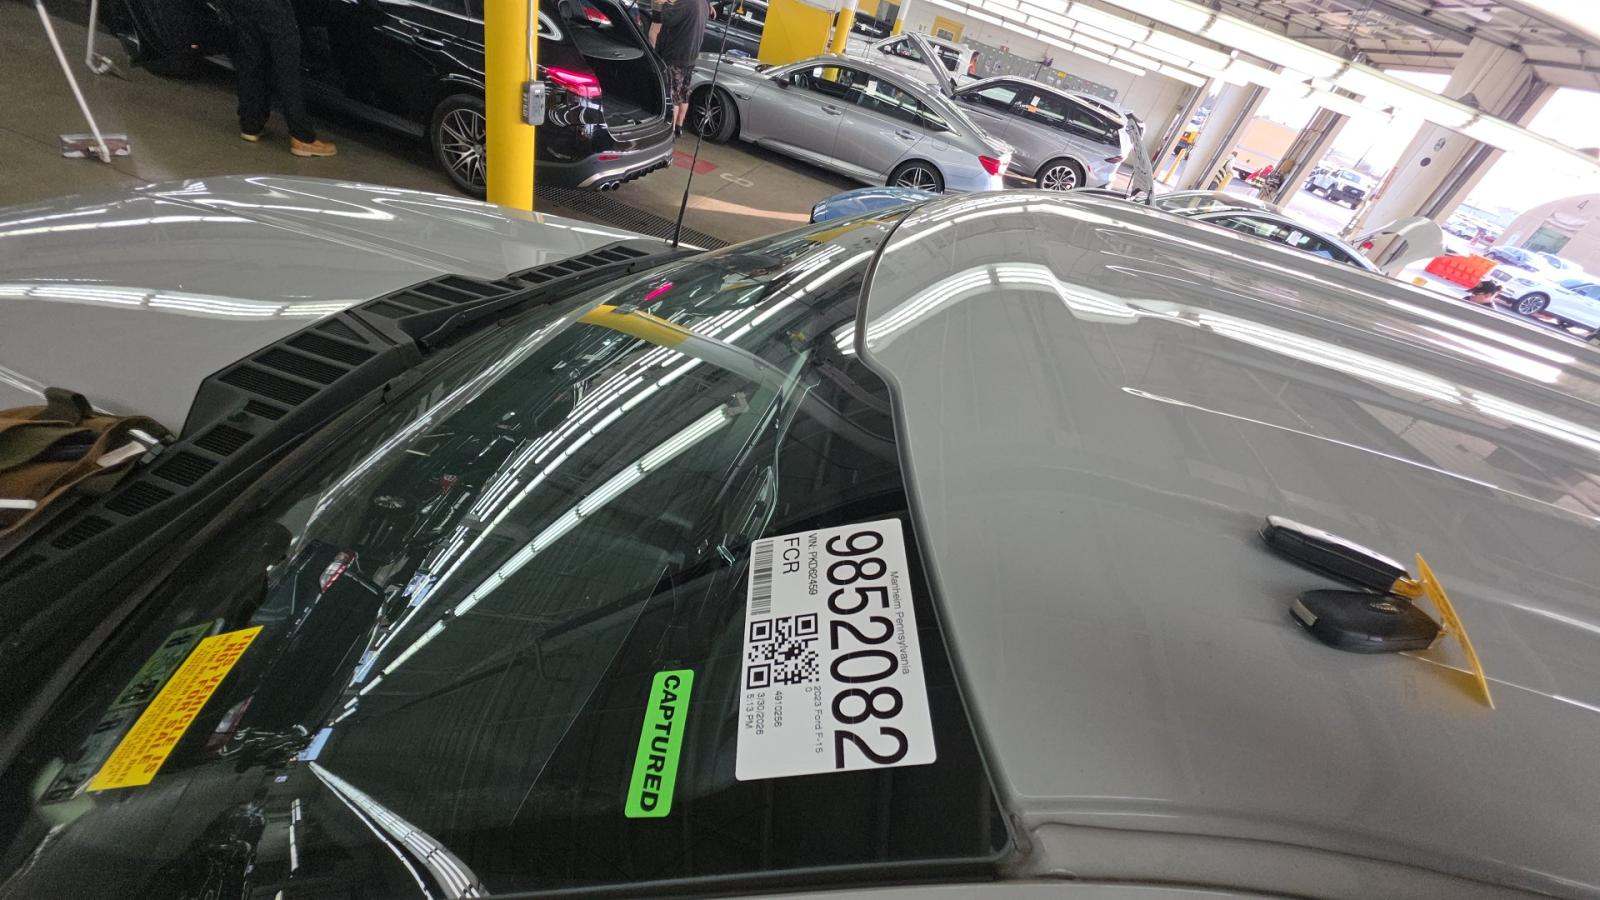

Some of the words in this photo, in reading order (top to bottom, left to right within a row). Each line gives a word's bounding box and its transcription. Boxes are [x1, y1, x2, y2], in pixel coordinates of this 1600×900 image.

[782, 537, 800, 575] FCR
[808, 533, 818, 549] VIN:
[808, 551, 819, 596] PKD62459
[890, 571, 902, 610] Manheim
[208, 642, 237, 672] NOT
[222, 633, 256, 667] THIS
[825, 530, 909, 769] 9852082
[895, 611, 910, 675] Pennsylvania
[162, 673, 223, 747] VEHICLE
[175, 679, 209, 712] FOR
[813, 685, 822, 707] 2023
[745, 714, 754, 729] PM
[814, 709, 823, 730] Ford
[138, 719, 179, 765] SALE
[639, 674, 681, 812] CAPTURED
[143, 755, 164, 774] IS
